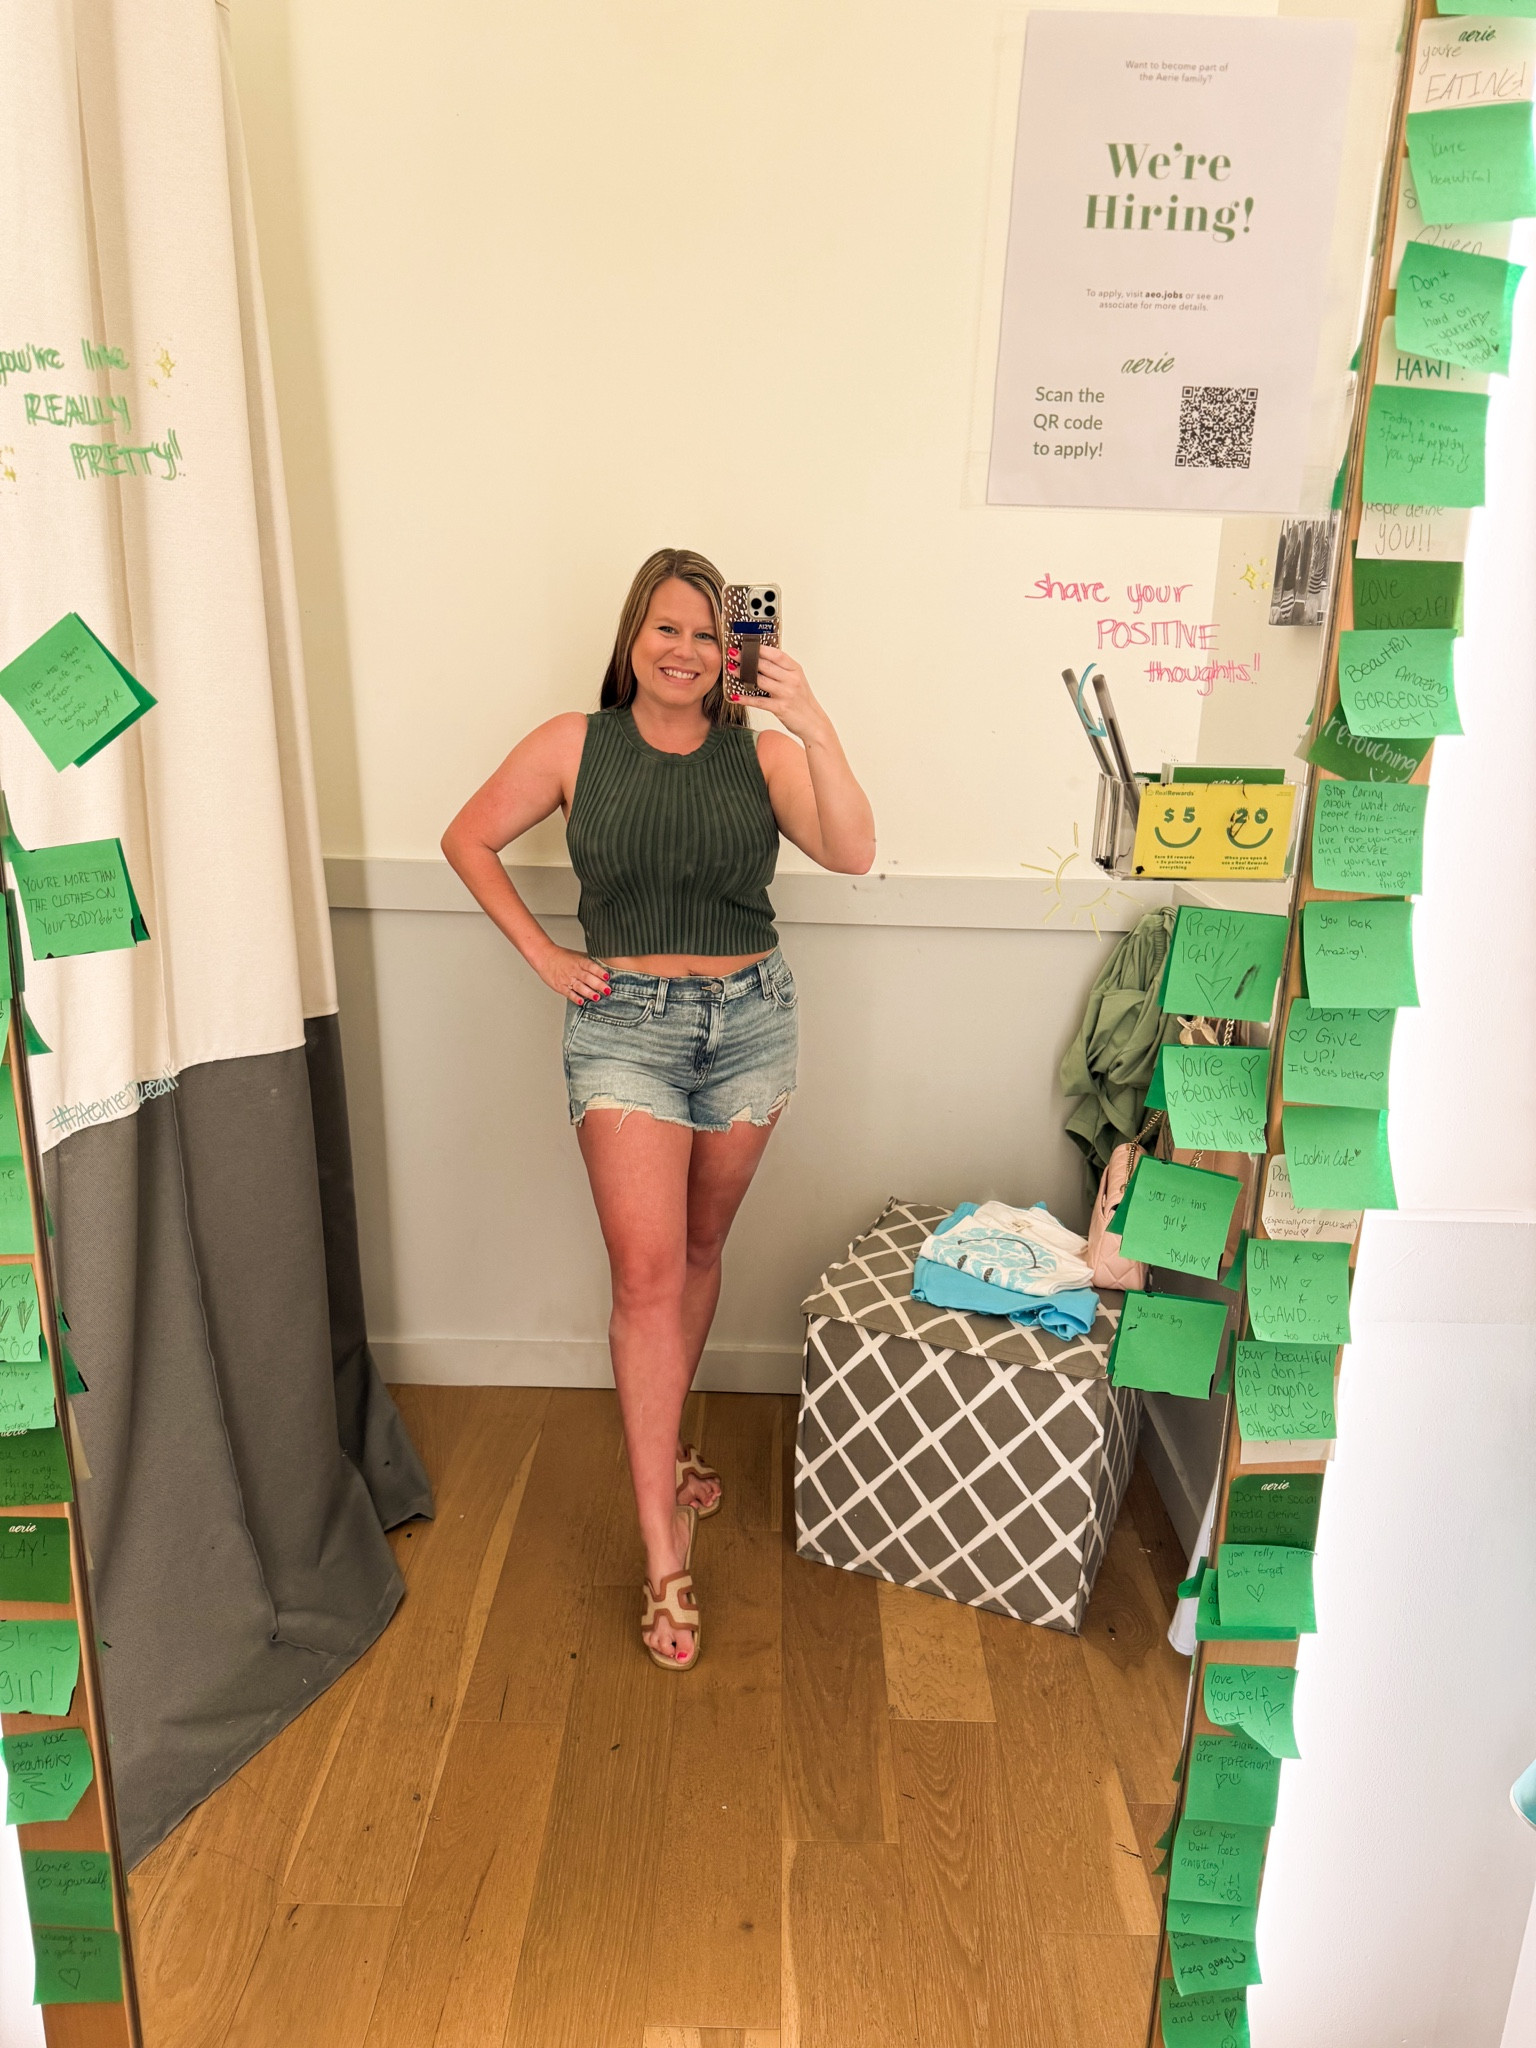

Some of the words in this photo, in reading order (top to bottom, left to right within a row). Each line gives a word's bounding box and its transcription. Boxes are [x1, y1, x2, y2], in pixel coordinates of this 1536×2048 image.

[1458, 26, 1496, 42] aerie
[1126, 60, 1148, 69] Want
[1162, 61, 1196, 70] become
[1199, 62, 1216, 72] part
[1219, 63, 1228, 72] of
[1139, 72, 1153, 81] the
[1156, 73, 1179, 82] Aerie
[1181, 74, 1213, 84] family?
[1106, 142, 1231, 181] We're
[1084, 193, 1254, 243] Hiring!
[1086, 288, 1096, 297] To
[1098, 289, 1124, 299] apply,
[1126, 290, 1143, 298] visit
[1145, 290, 1183, 300] aeo.jobs
[1099, 300, 1138, 309] associate
[1140, 301, 1152, 310] for
[1154, 302, 1177, 311] more
[1179, 302, 1209, 312] details.
[1418, 296, 1432, 309] be
[1422, 314, 1448, 328] hard
[1121, 352, 1175, 374] aerie
[1035, 386, 1073, 403] Scan
[1078, 388, 1105, 404] the
[24, 393, 131, 435] REALLY
[1033, 414, 1060, 432] QR
[1064, 415, 1103, 430] code
[1033, 442, 1050, 456] to
[1054, 442, 1103, 460] apply!
[1127, 583, 1193, 614] your
[1097, 619, 1221, 650] POSITIVE
[1345, 635, 1413, 683] Beautiful
[1395, 665, 1448, 702] Amazing
[1354, 691, 1439, 710] GORGEOUS
[1324, 784, 1345, 798] Stop
[1323, 801, 1352, 809] about
[1361, 801, 1388, 812] what
[1320, 810, 1349, 820] people
[1348, 826, 1379, 834] doubt
[1318, 836, 1335, 844] live
[1318, 846, 1341, 854] and
[64, 872, 89, 887] MORE
[91, 869, 116, 883] THAN
[1376, 870, 1392, 881] you
[1397, 870, 1412, 881] got
[1379, 880, 1396, 889] this
[28, 898, 48, 913] THE
[52, 892, 95, 908] CLOTHES
[96, 887, 116, 900] ON
[1306, 1008, 1361, 1022] Don't
[1315, 1028, 1361, 1046] Give
[1303, 1049, 1335, 1064] UP!
[1312, 1066, 1337, 1078] gets
[1340, 1069, 1370, 1080] better
[1182, 1071, 1256, 1103] Beautiful
[1230, 1105, 1258, 1125] the
[1190, 1196, 1207, 1211] this
[1254, 1246, 1269, 1270] OH
[1269, 1275, 1288, 1293] MY
[1284, 1330, 1299, 1340] too
[1312, 1330, 1332, 1342] cute
[1275, 1346, 1332, 1367] beautiful
[1238, 1379, 1262, 1396] let
[1267, 1380, 1320, 1404] anyone
[1238, 1402, 1259, 1416] tell
[1260, 1479, 1290, 1491] aerie
[9, 1522, 37, 1533] aerie
[1210, 1670, 1233, 1684] love
[1210, 1686, 1268, 1704] yourself
[12, 1754, 61, 1773] beautiful
[1196, 1752, 1213, 1762] are
[1198, 1873, 1216, 1891] Buy
[1208, 1955, 1235, 1976] going
[1169, 1995, 1214, 2009] beautiful
[1171, 2012, 1194, 2024] and
[1201, 2012, 1221, 2022] out
